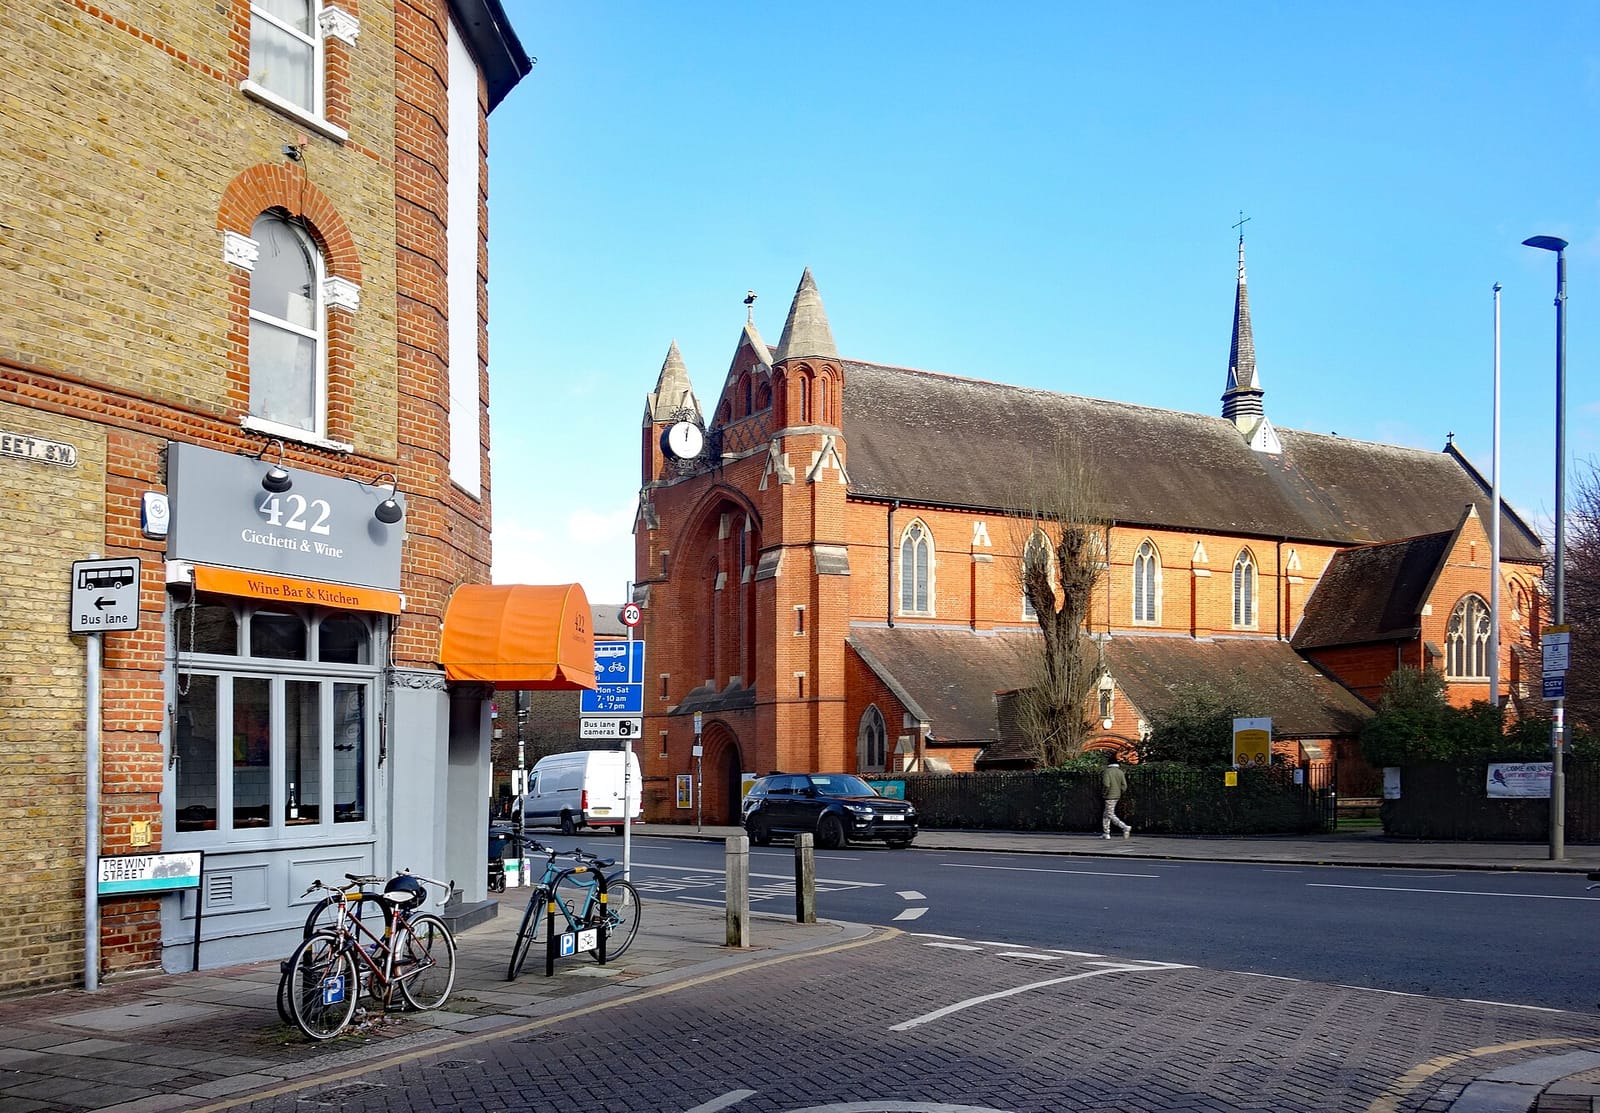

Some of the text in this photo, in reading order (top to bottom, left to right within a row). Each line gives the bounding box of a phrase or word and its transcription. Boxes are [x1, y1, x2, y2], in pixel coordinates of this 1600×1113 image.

[259, 492, 331, 536] 422
[241, 528, 343, 558] Cicchetti & Wine
[248, 580, 359, 605] Wine Bar & Kitchen
[81, 613, 128, 625] Bus lane
[626, 609, 638, 620] 20
[103, 857, 153, 869] TREWINT
[103, 868, 144, 881] STREET
[563, 935, 573, 955] P
[327, 979, 341, 1002] P
